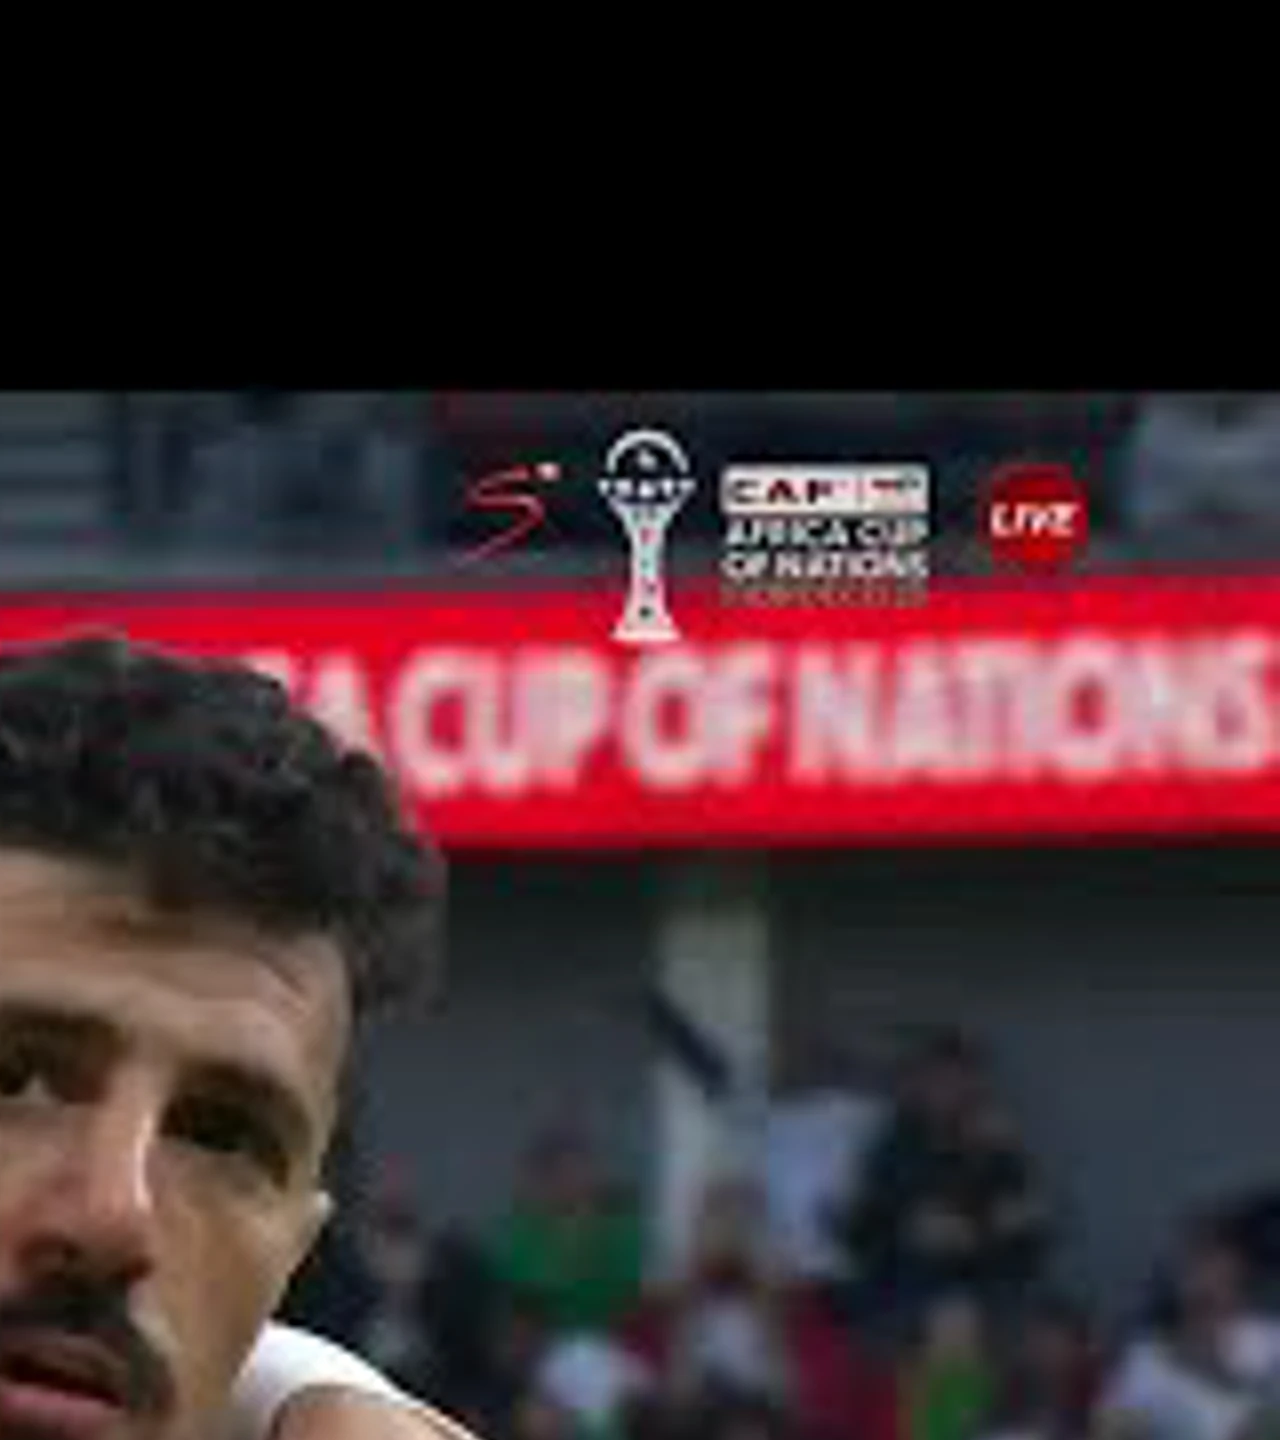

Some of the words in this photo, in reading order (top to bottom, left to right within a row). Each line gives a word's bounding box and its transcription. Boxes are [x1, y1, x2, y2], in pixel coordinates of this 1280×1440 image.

[388, 642, 610, 797] CUP
[620, 640, 775, 787] OF
[790, 628, 1280, 783] NATIONS
